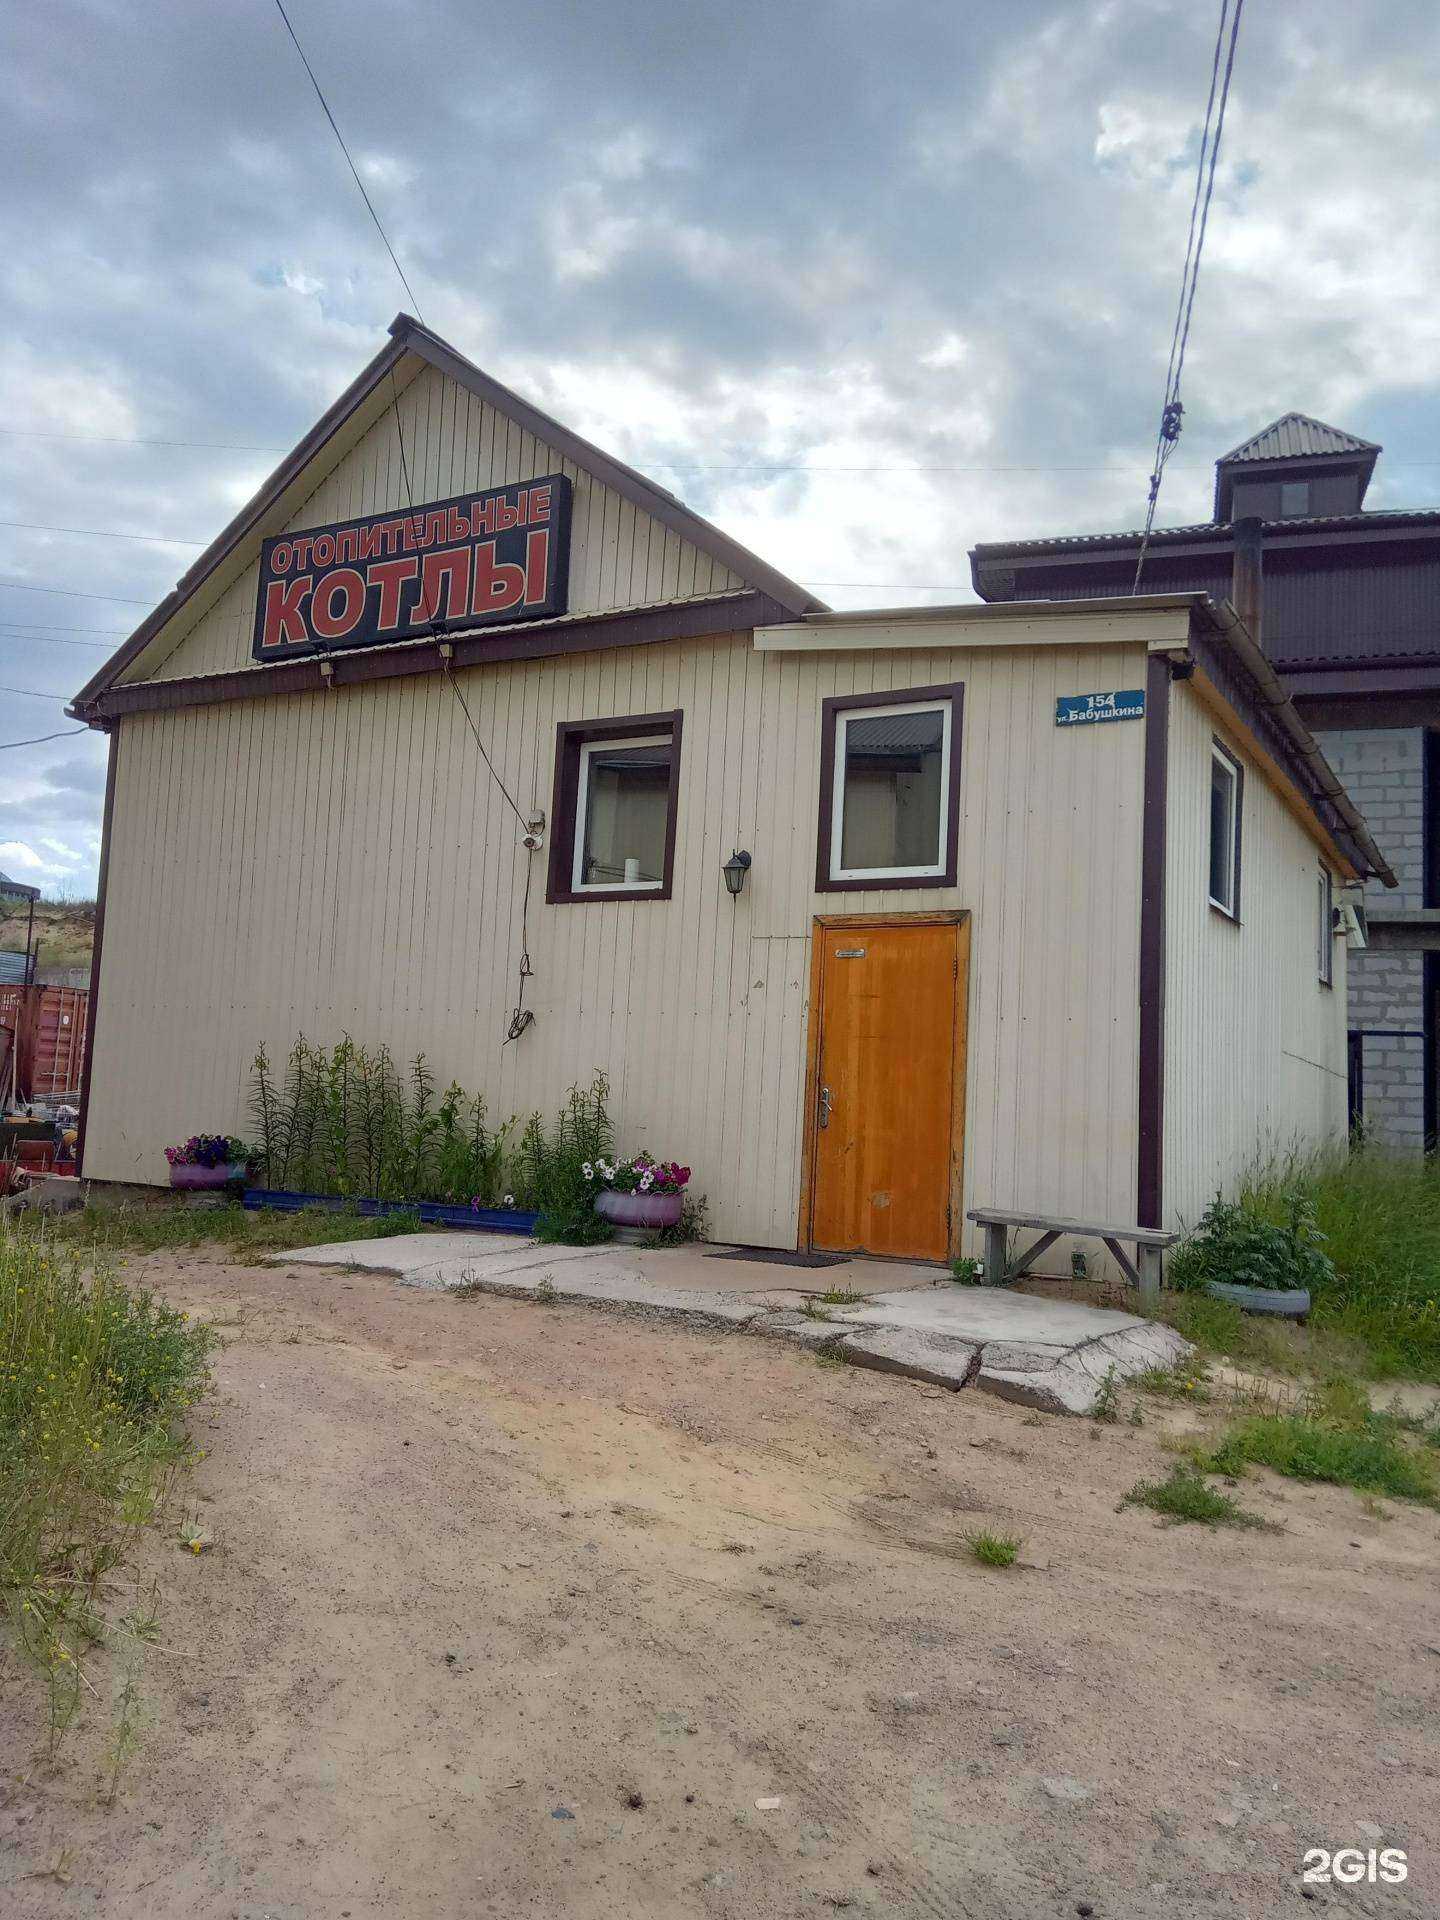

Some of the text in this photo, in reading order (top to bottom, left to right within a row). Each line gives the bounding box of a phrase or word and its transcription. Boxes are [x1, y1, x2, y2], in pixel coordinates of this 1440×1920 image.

[270, 485, 552, 575] ОТОПИТЕЛЬНЫЕ
[262, 528, 550, 648] КОТЛЫ
[1069, 706, 1144, 721] Бабушкина
